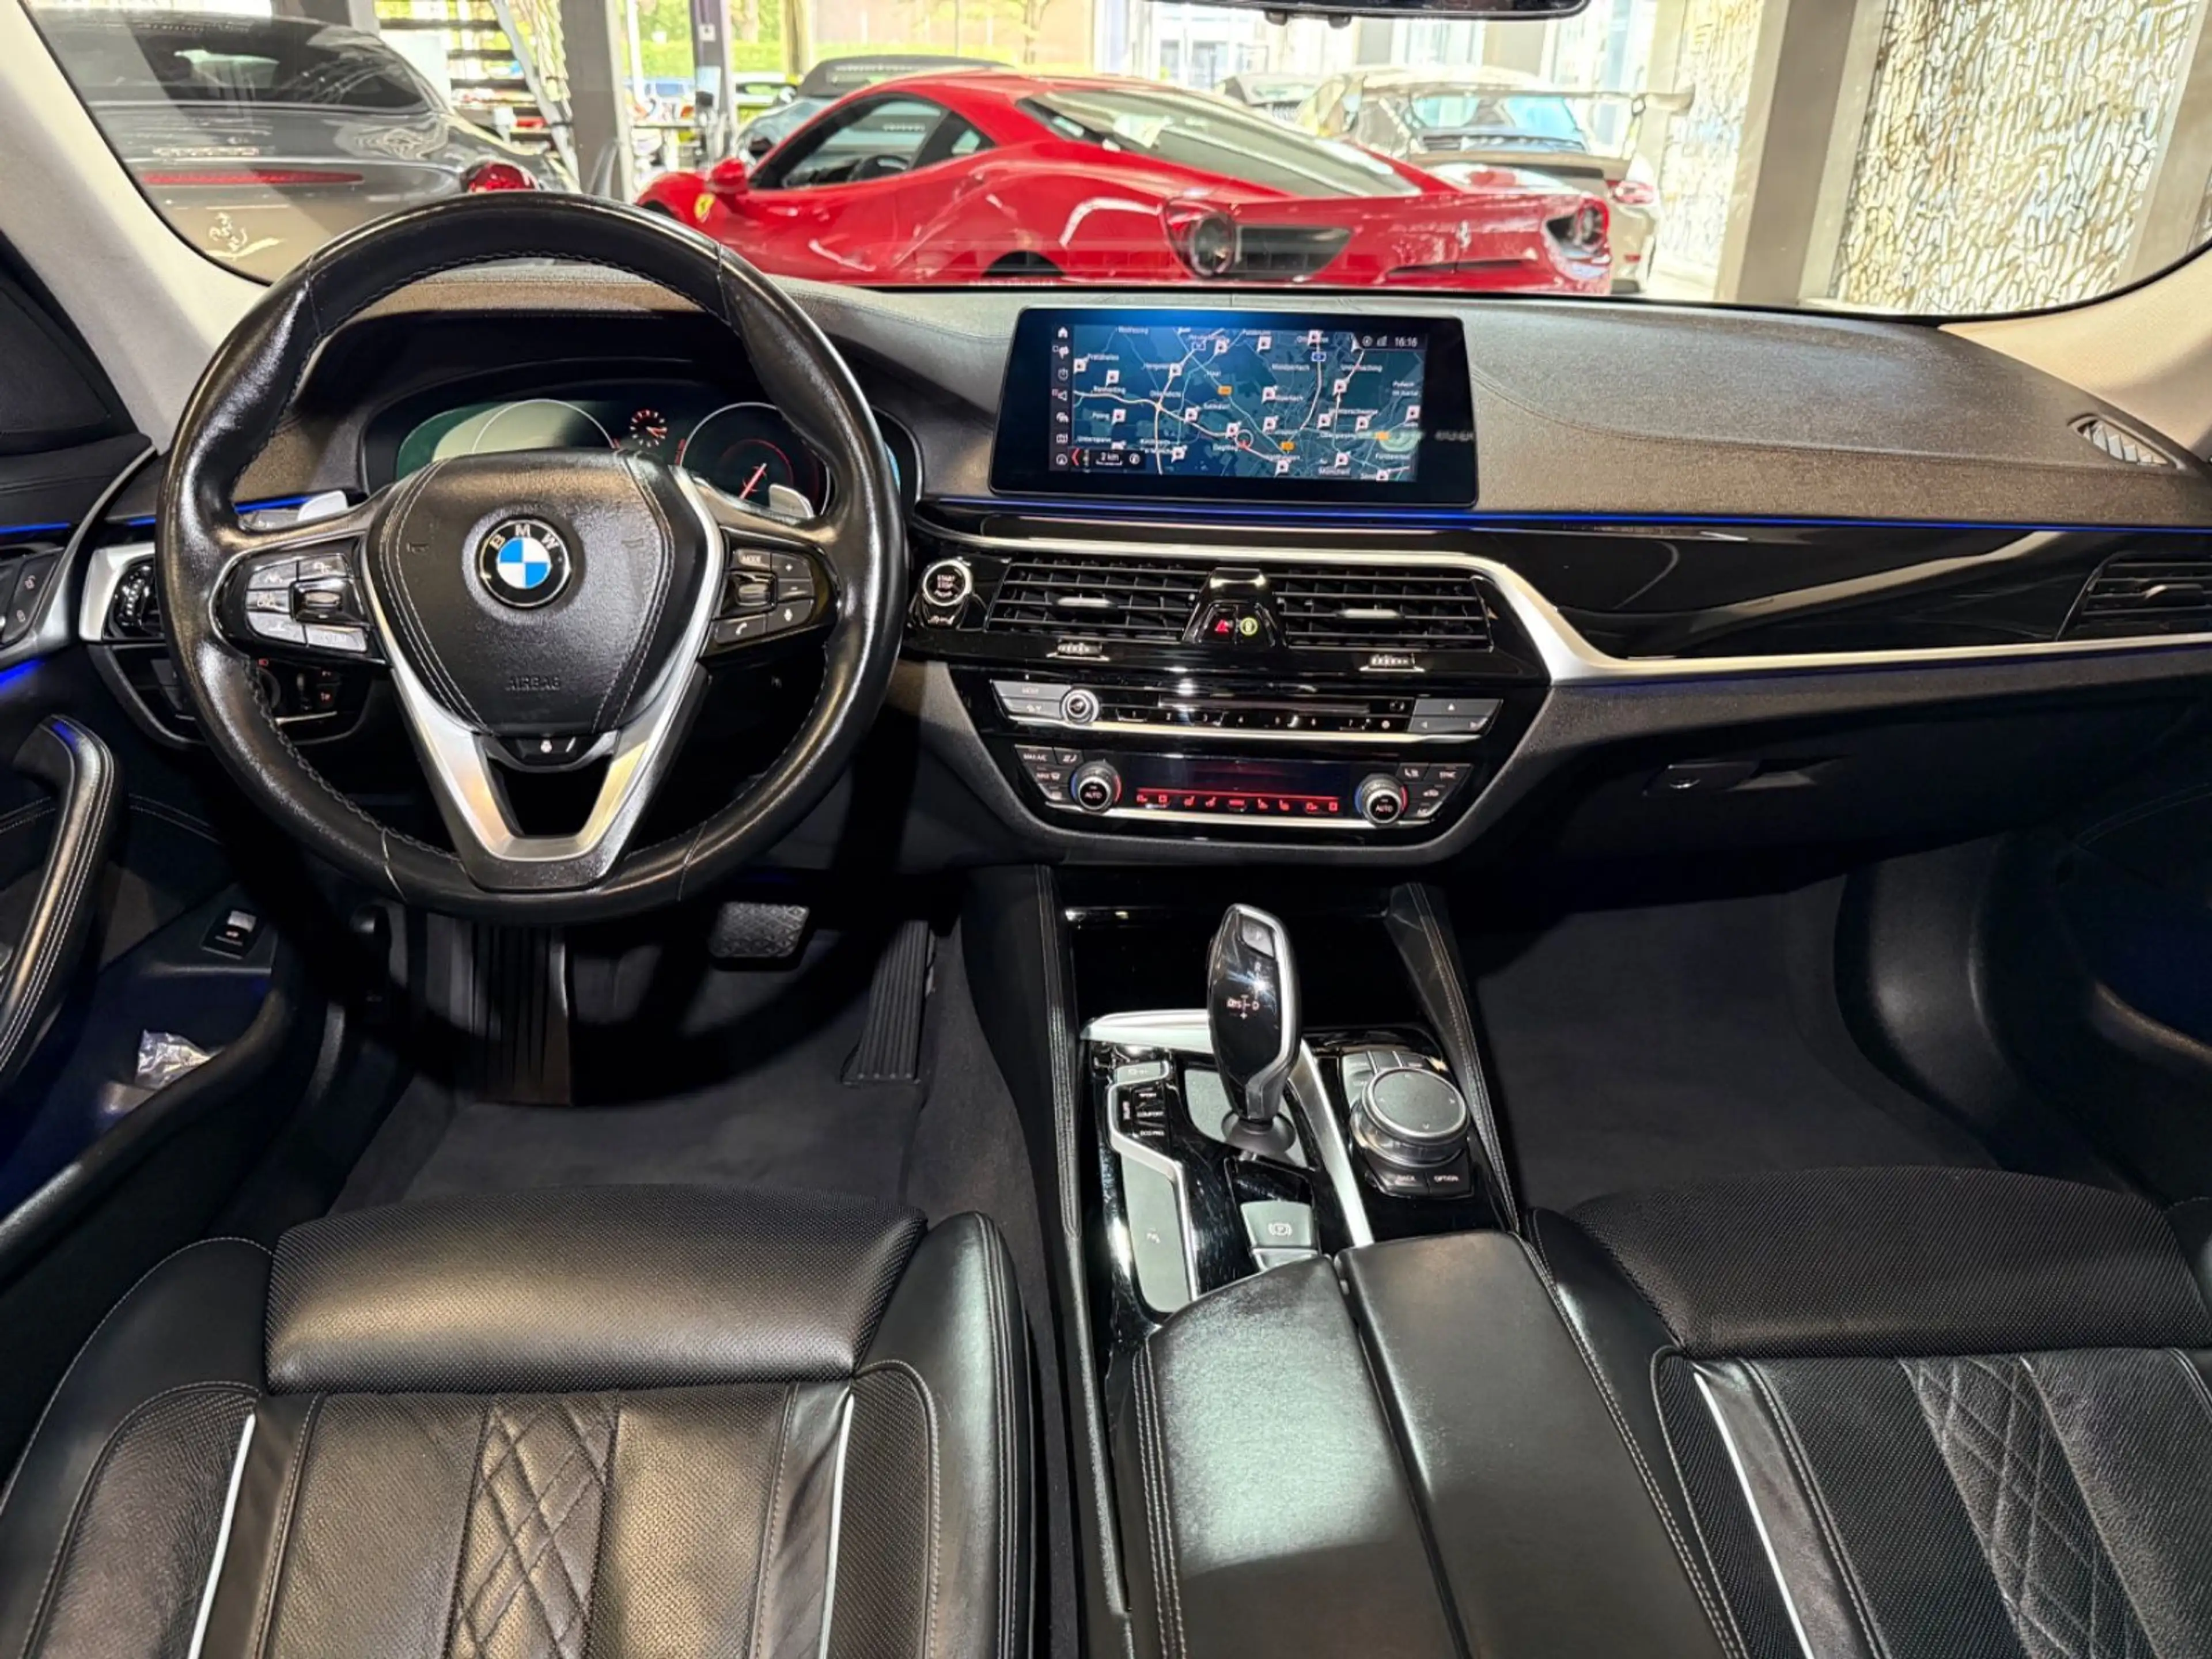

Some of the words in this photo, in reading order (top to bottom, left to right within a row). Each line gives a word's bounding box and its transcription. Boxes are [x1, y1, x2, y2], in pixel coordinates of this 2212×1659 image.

[1100, 452, 1105, 461] 2
[1107, 452, 1119, 461] km
[490, 524, 559, 550] BMW
[505, 675, 561, 691] AIRBAG
[1375, 804, 1393, 813] AUTO
